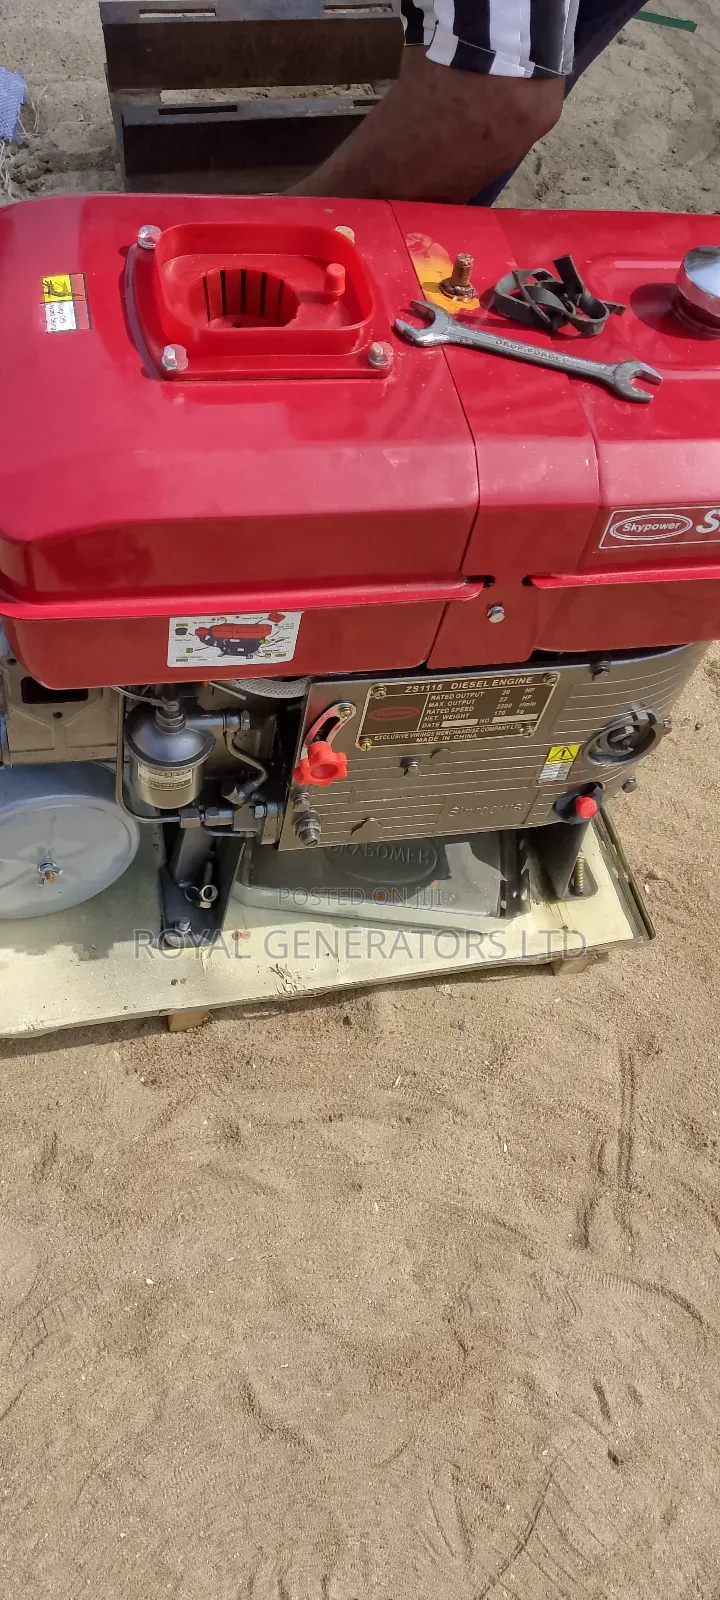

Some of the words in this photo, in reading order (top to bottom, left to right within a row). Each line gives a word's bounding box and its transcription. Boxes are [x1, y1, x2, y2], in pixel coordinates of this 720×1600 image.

[622, 522, 681, 533] Skypower
[404, 683, 444, 693] ZS1115
[450, 680, 489, 690] DIESEL
[491, 676, 534, 687] ENGINE
[455, 691, 485, 699] OUTPUT
[447, 699, 477, 707] OUTPUT
[374, 733, 409, 741] EXCLUSIVE
[480, 723, 509, 732] COMPANY
[453, 732, 478, 740] CHINA
